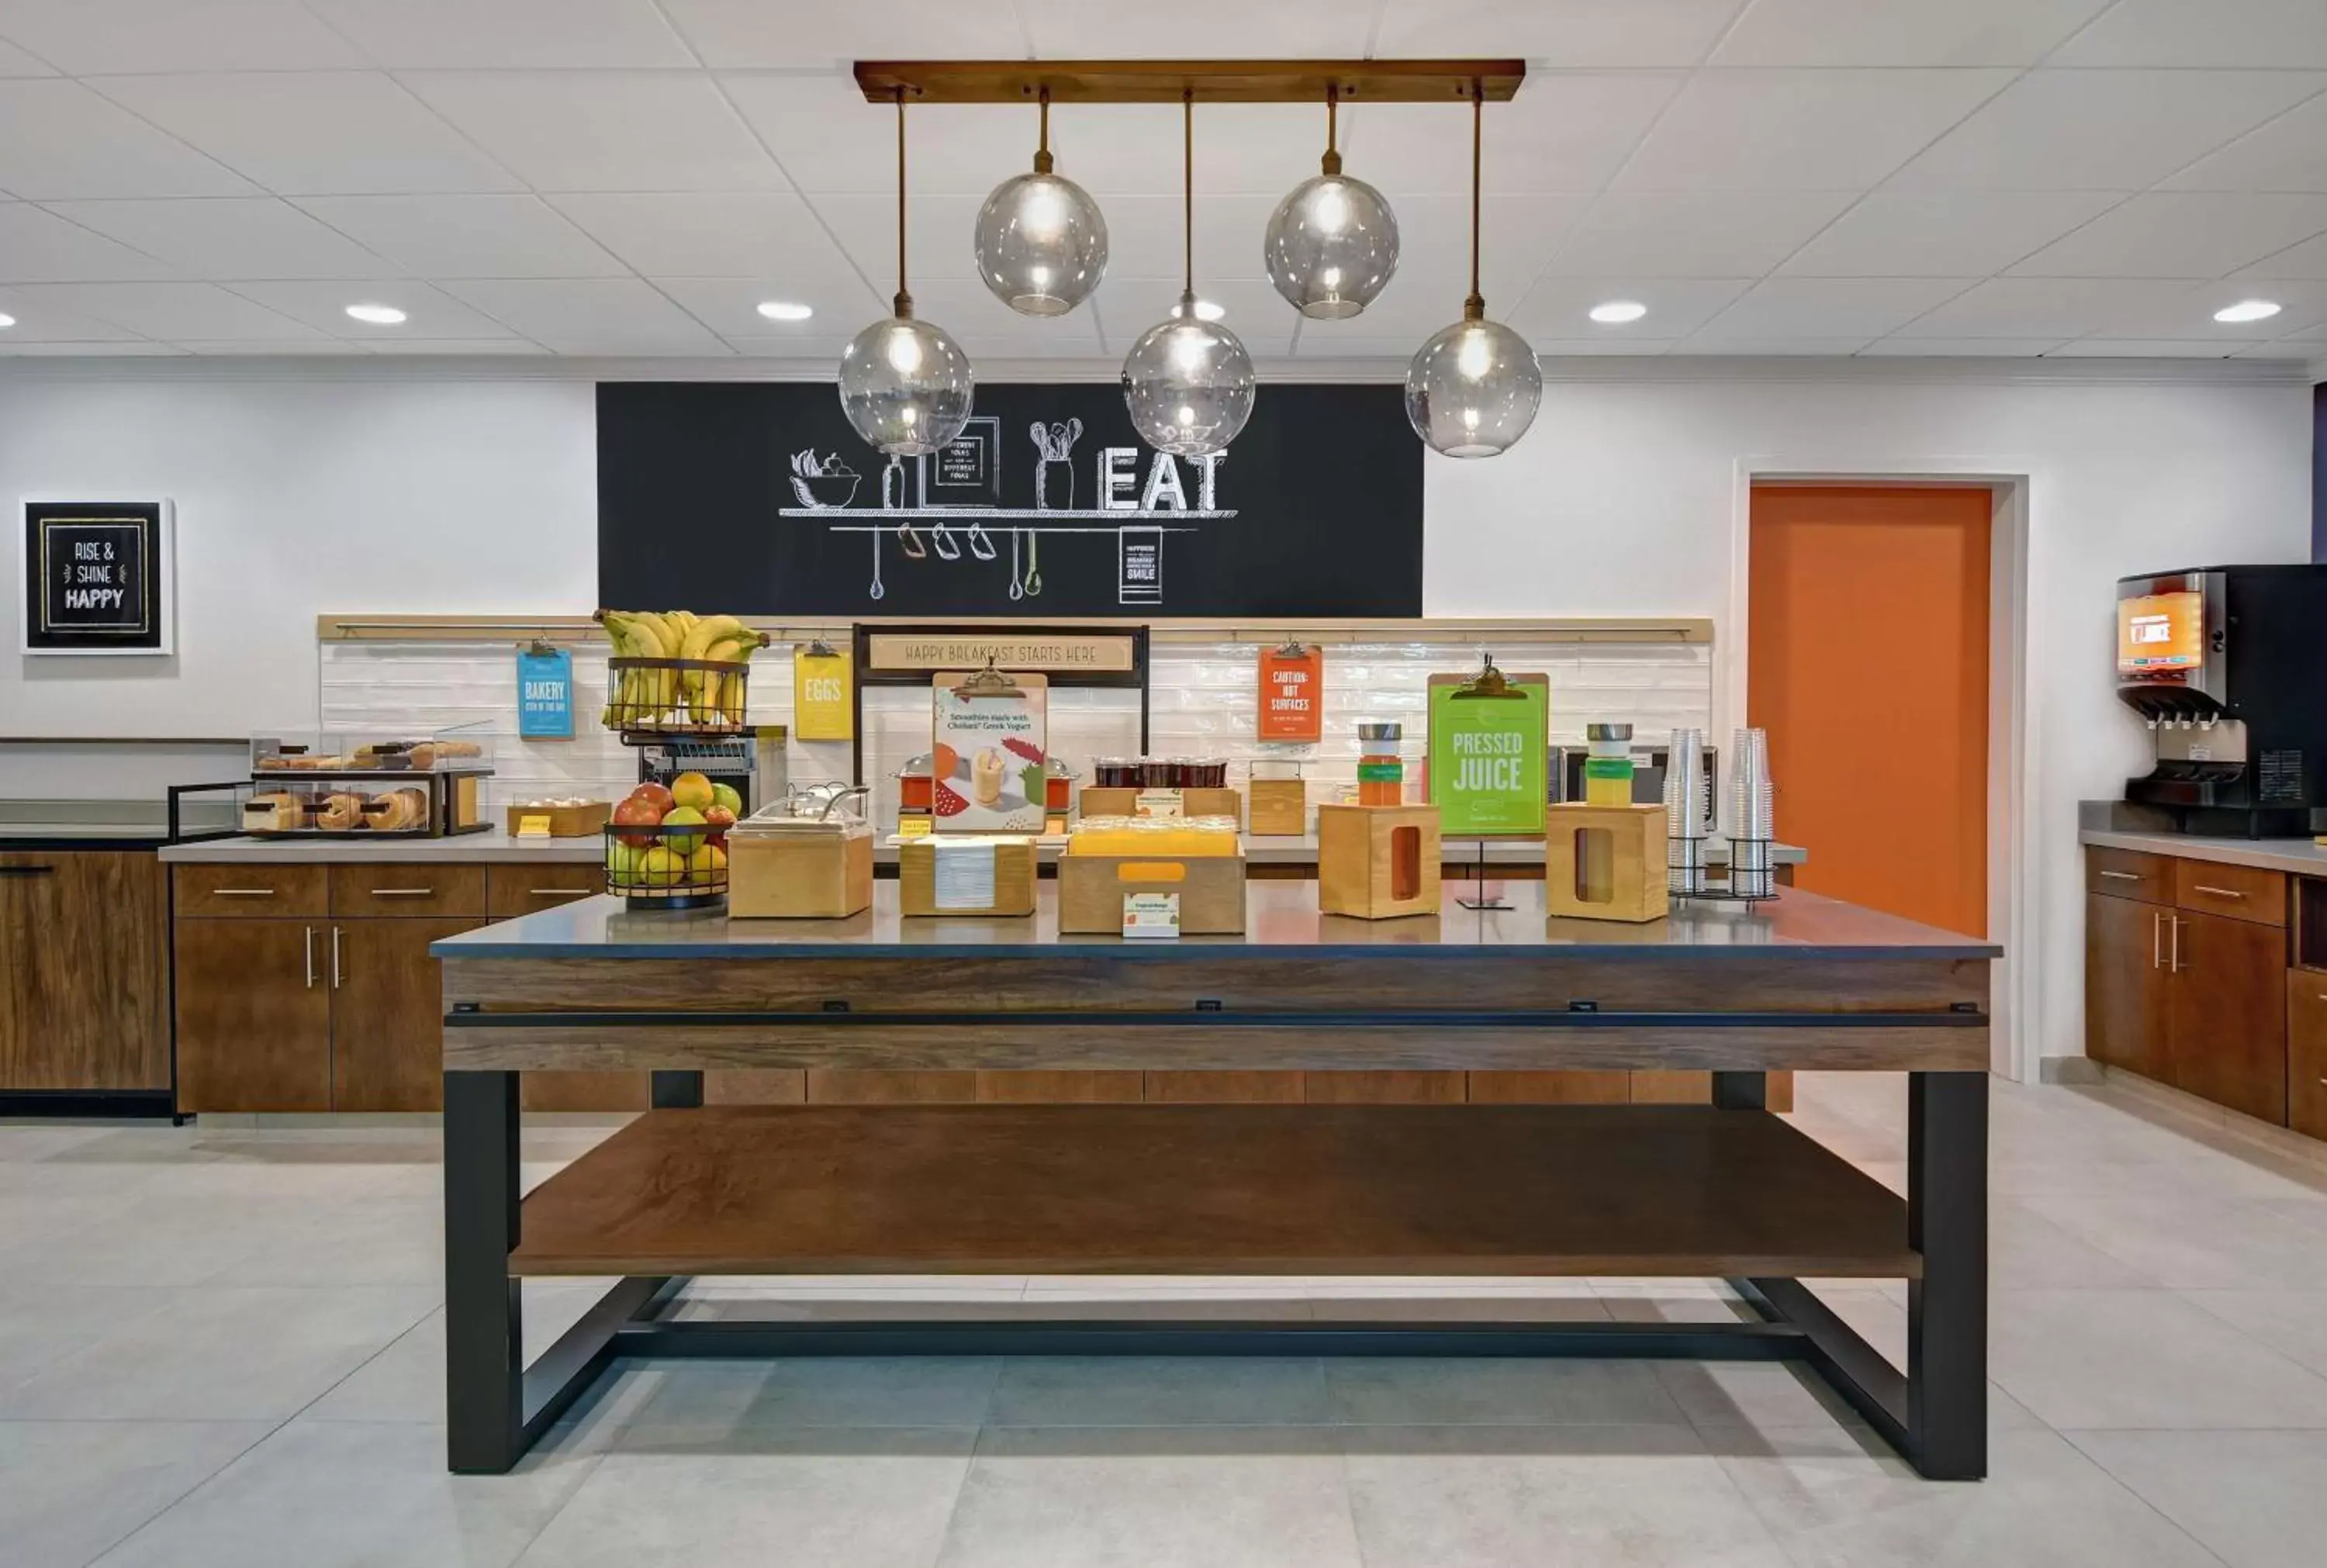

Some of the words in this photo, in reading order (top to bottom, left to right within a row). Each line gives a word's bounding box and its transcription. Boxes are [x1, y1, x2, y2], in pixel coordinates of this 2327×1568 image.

[1097, 447, 1228, 509] EAT
[75, 542, 100, 560] RISE
[103, 542, 115, 560] &
[78, 565, 112, 583] SHINE
[1127, 568, 1155, 580] SMILE
[65, 589, 124, 609] HAPPY
[905, 644, 944, 661] HAPPY
[948, 645, 1015, 662] BREAKFAST
[1018, 645, 1062, 662] STARTS
[1066, 646, 1097, 662] HERE
[525, 681, 565, 700] BAKERY
[805, 678, 842, 702] EGGS
[1281, 685, 1298, 697] HOT
[1271, 698, 1309, 711] SURFACES
[950, 713, 990, 721] Smoothies
[1006, 722, 1031, 731] Yogurt
[1453, 732, 1523, 755] PRESSED
[1452, 758, 1524, 792] JUICE
